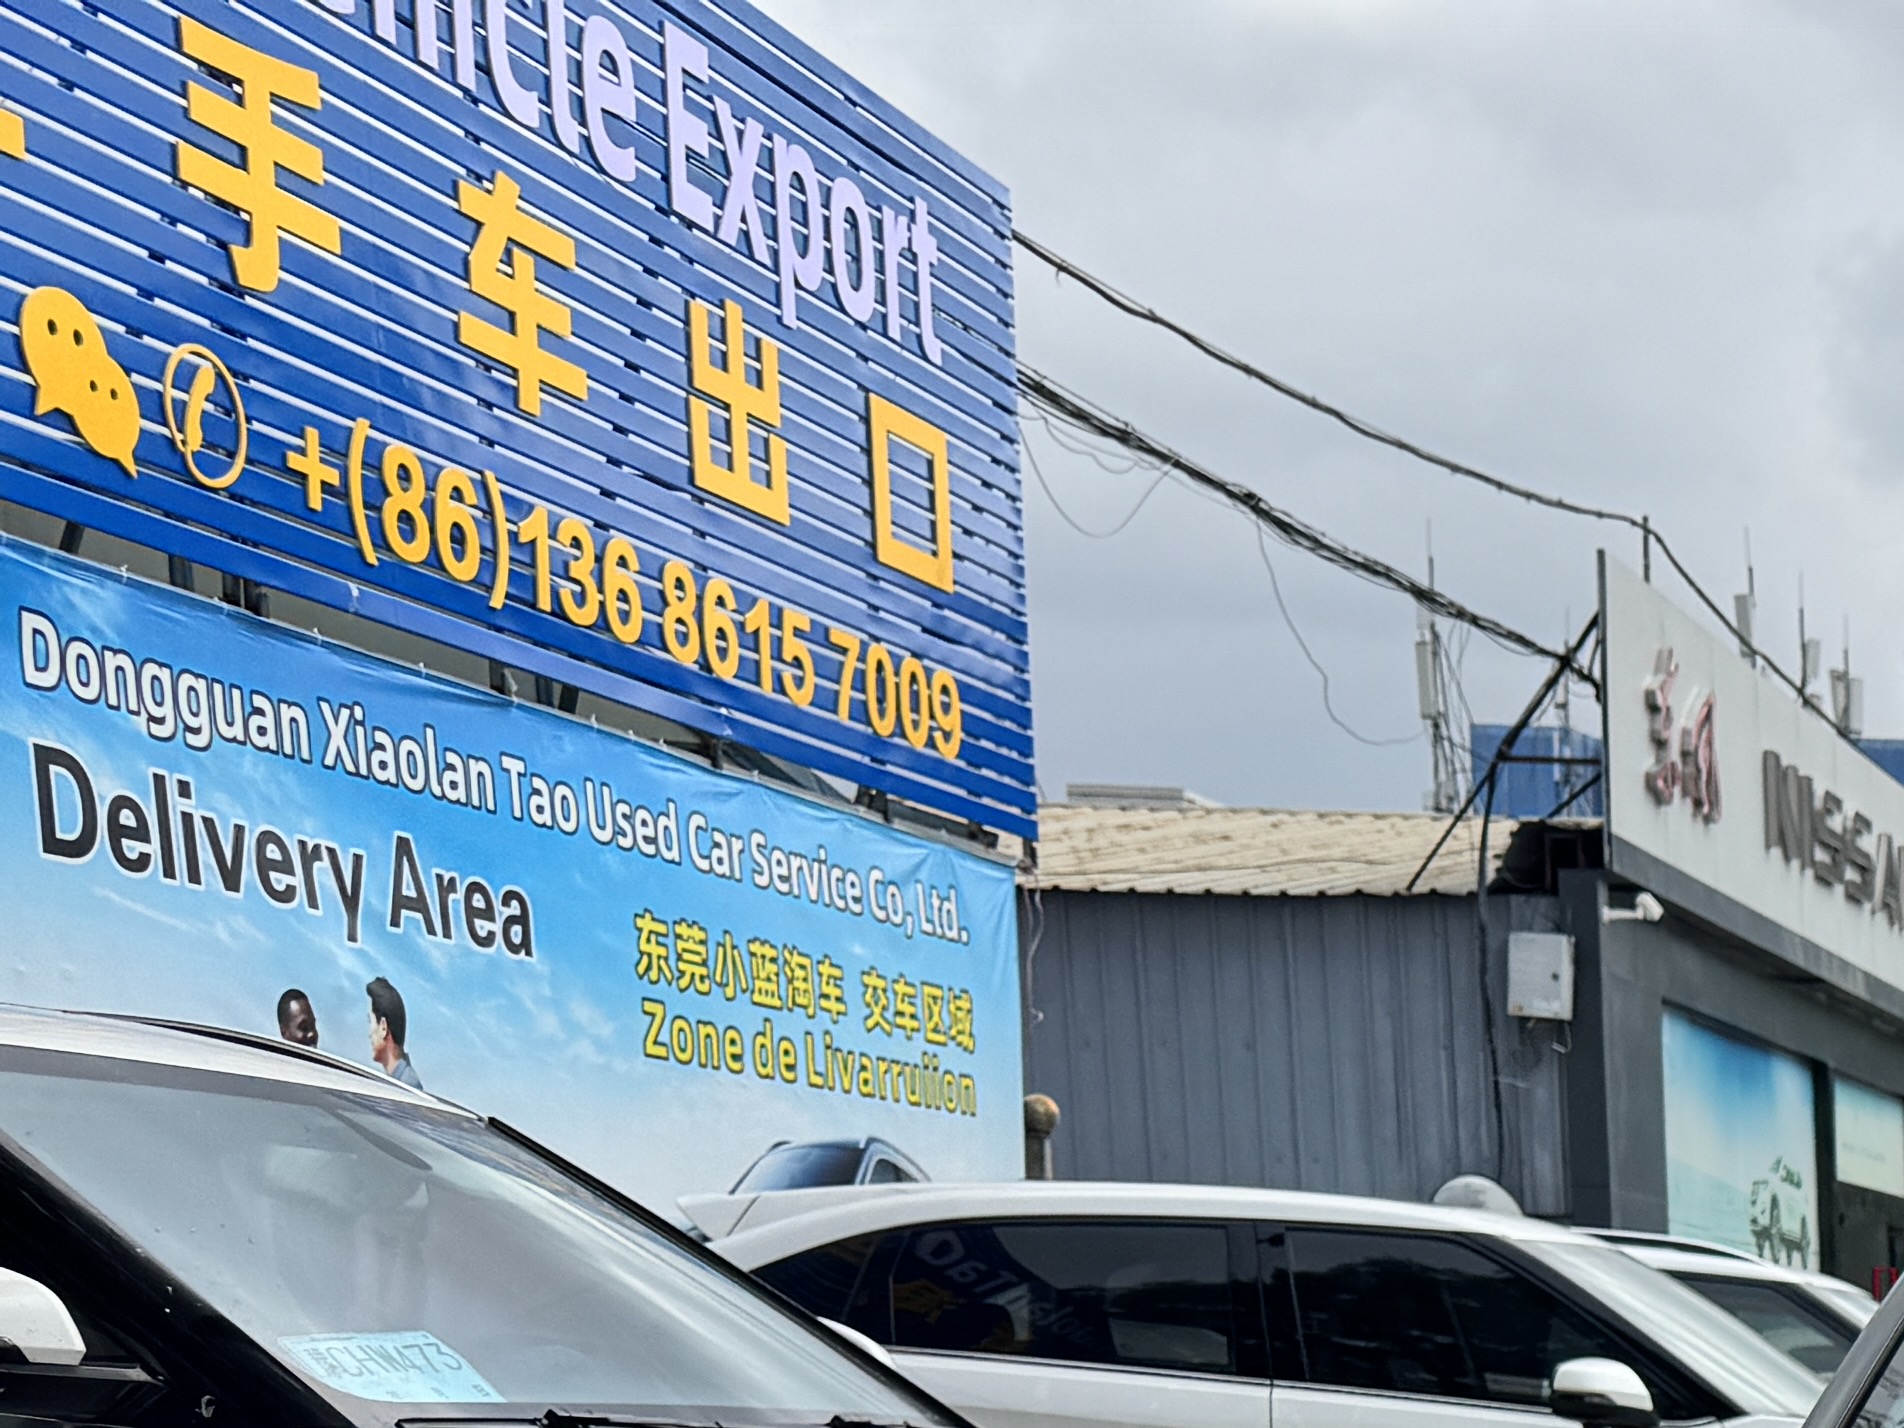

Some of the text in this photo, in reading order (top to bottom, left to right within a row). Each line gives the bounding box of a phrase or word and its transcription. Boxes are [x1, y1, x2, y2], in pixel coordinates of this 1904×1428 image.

[662, 19, 943, 366] Export
[0, 14, 955, 593] 手车出口
[18, 607, 312, 761] Dongguan
[318, 697, 496, 812] Xiaolan
[500, 751, 580, 833] Tao
[585, 777, 681, 864] Used
[688, 812, 744, 881] Car
[749, 830, 864, 914] Service
[661, 560, 816, 706] 8615
[829, 629, 962, 759] 7009
[31, 741, 535, 959] Delivery Area
[634, 908, 976, 1053] 东莞小蓝淘车 交车区域
[642, 997, 744, 1073] Zone
[753, 1017, 797, 1085] de
